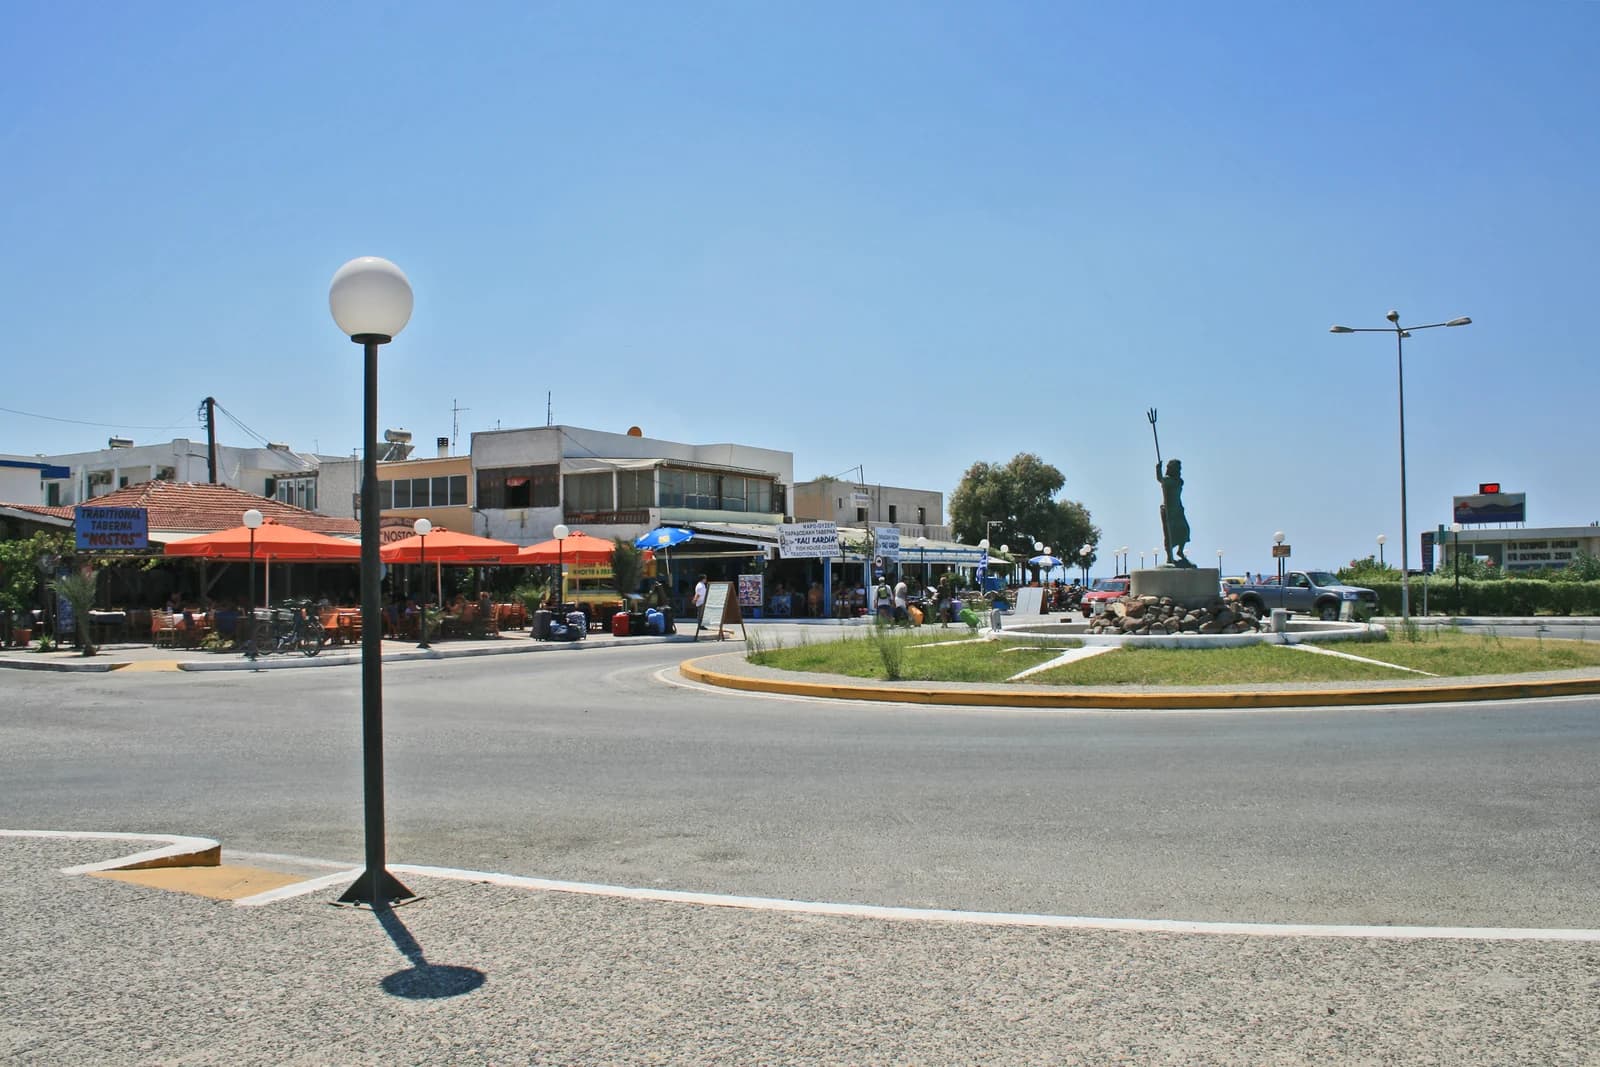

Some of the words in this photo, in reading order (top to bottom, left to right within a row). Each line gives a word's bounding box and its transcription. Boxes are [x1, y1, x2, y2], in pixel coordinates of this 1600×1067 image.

[81, 509, 140, 520] TRADITIONAL
[91, 520, 133, 531] TABERNA
[82, 532, 143, 545] "NOSTOS"
